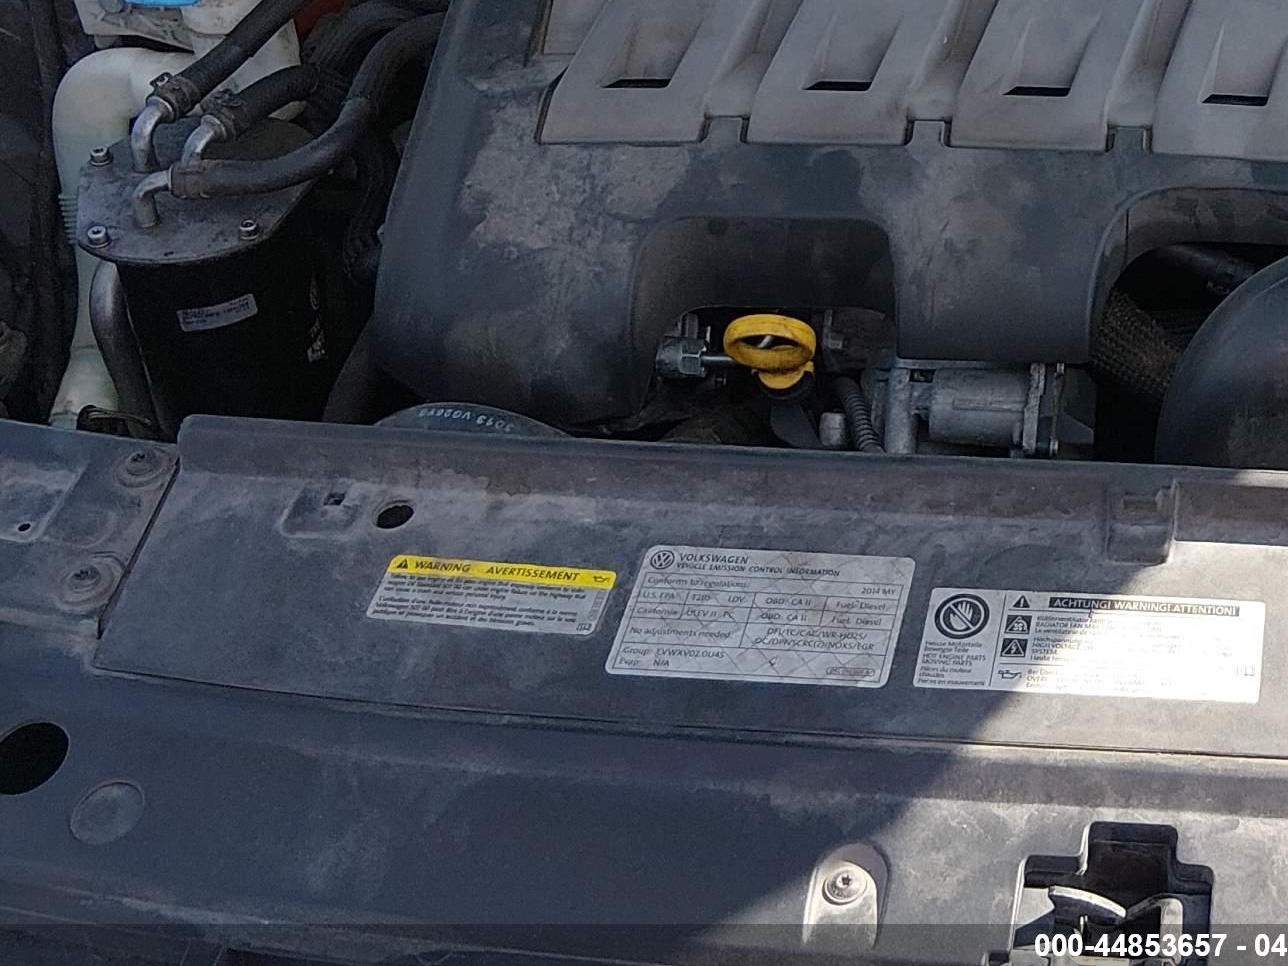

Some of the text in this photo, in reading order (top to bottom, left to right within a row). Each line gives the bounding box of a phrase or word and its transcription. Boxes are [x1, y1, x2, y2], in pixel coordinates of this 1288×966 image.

[680, 553, 749, 564] VOLKSWAGEN
[414, 561, 472, 573] WARNING
[486, 565, 580, 581] AVERTISSEMENT
[677, 562, 841, 576] VEHICLE EMISSION CONTROL INFORMATION
[1054, 598, 1236, 616] ACHTUNG! WARNING! ATTENTION!
